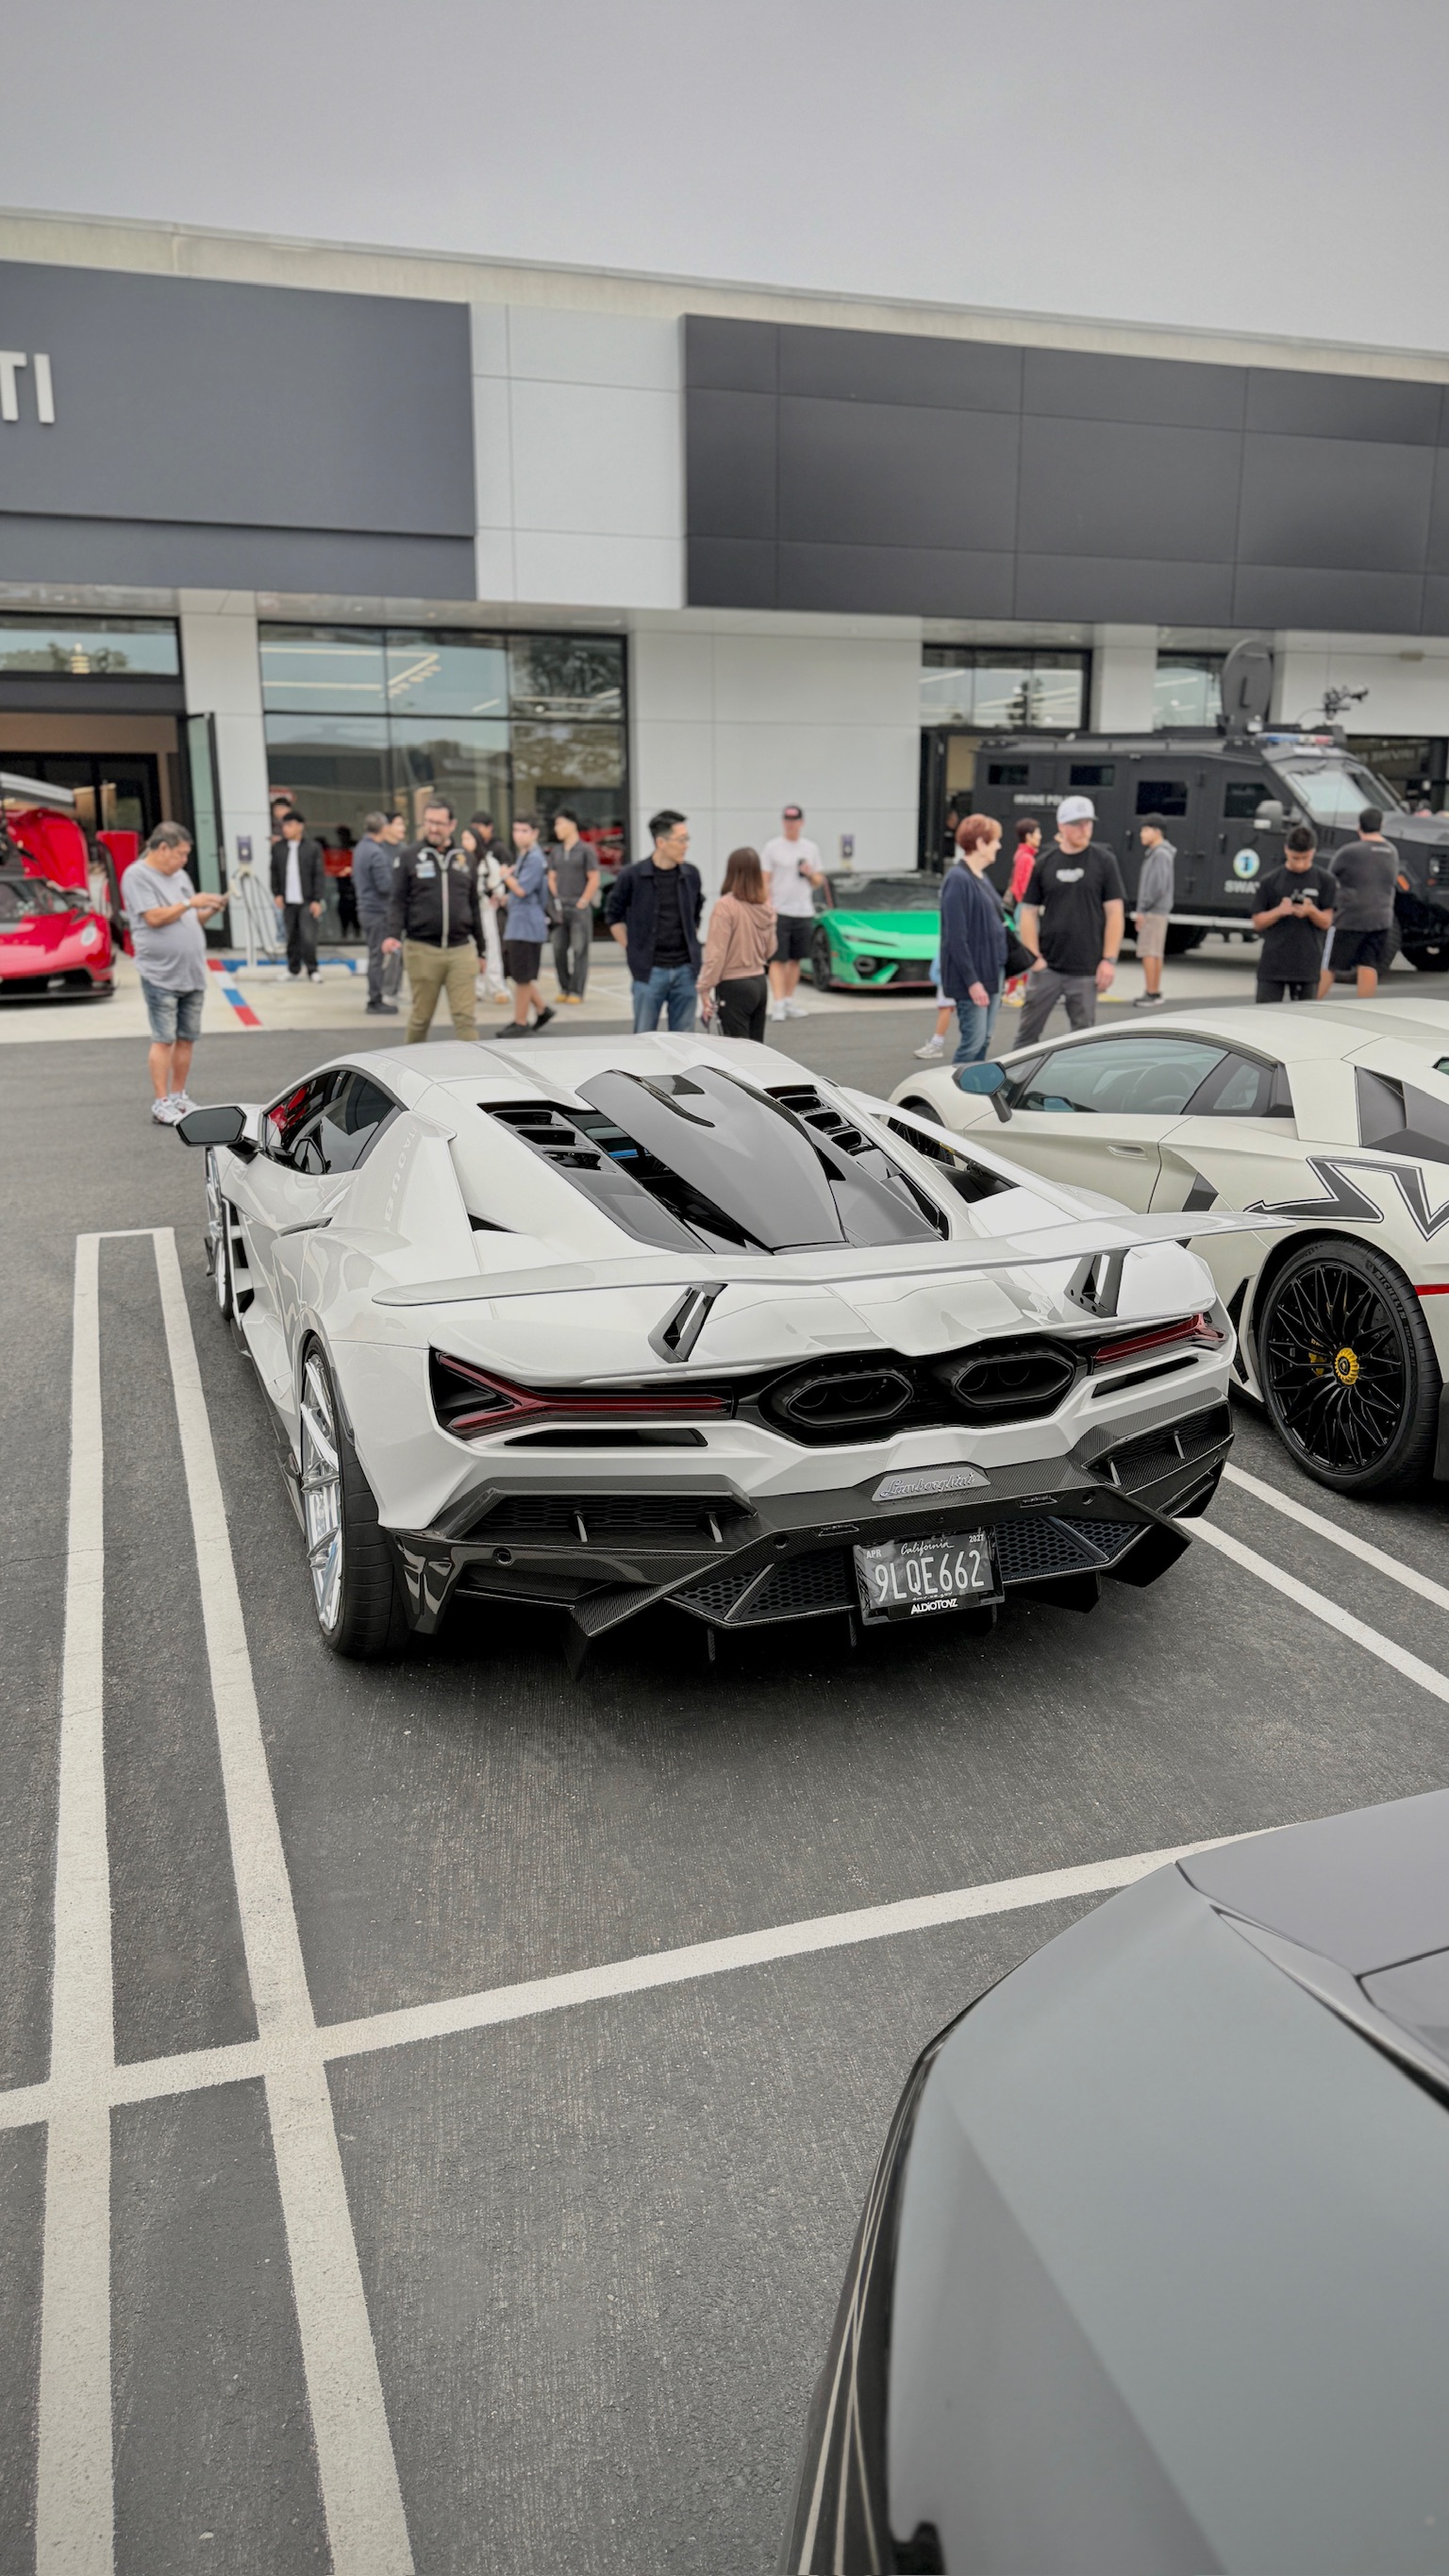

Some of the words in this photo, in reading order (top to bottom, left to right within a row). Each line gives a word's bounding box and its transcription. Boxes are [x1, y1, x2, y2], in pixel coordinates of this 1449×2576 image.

[1374, 1270, 1407, 1319] MICHELIN
[879, 1472, 975, 1497] Lamborghini
[866, 1548, 882, 1559] APR
[901, 1538, 955, 1557] California
[874, 1549, 985, 1602] 9LQE662
